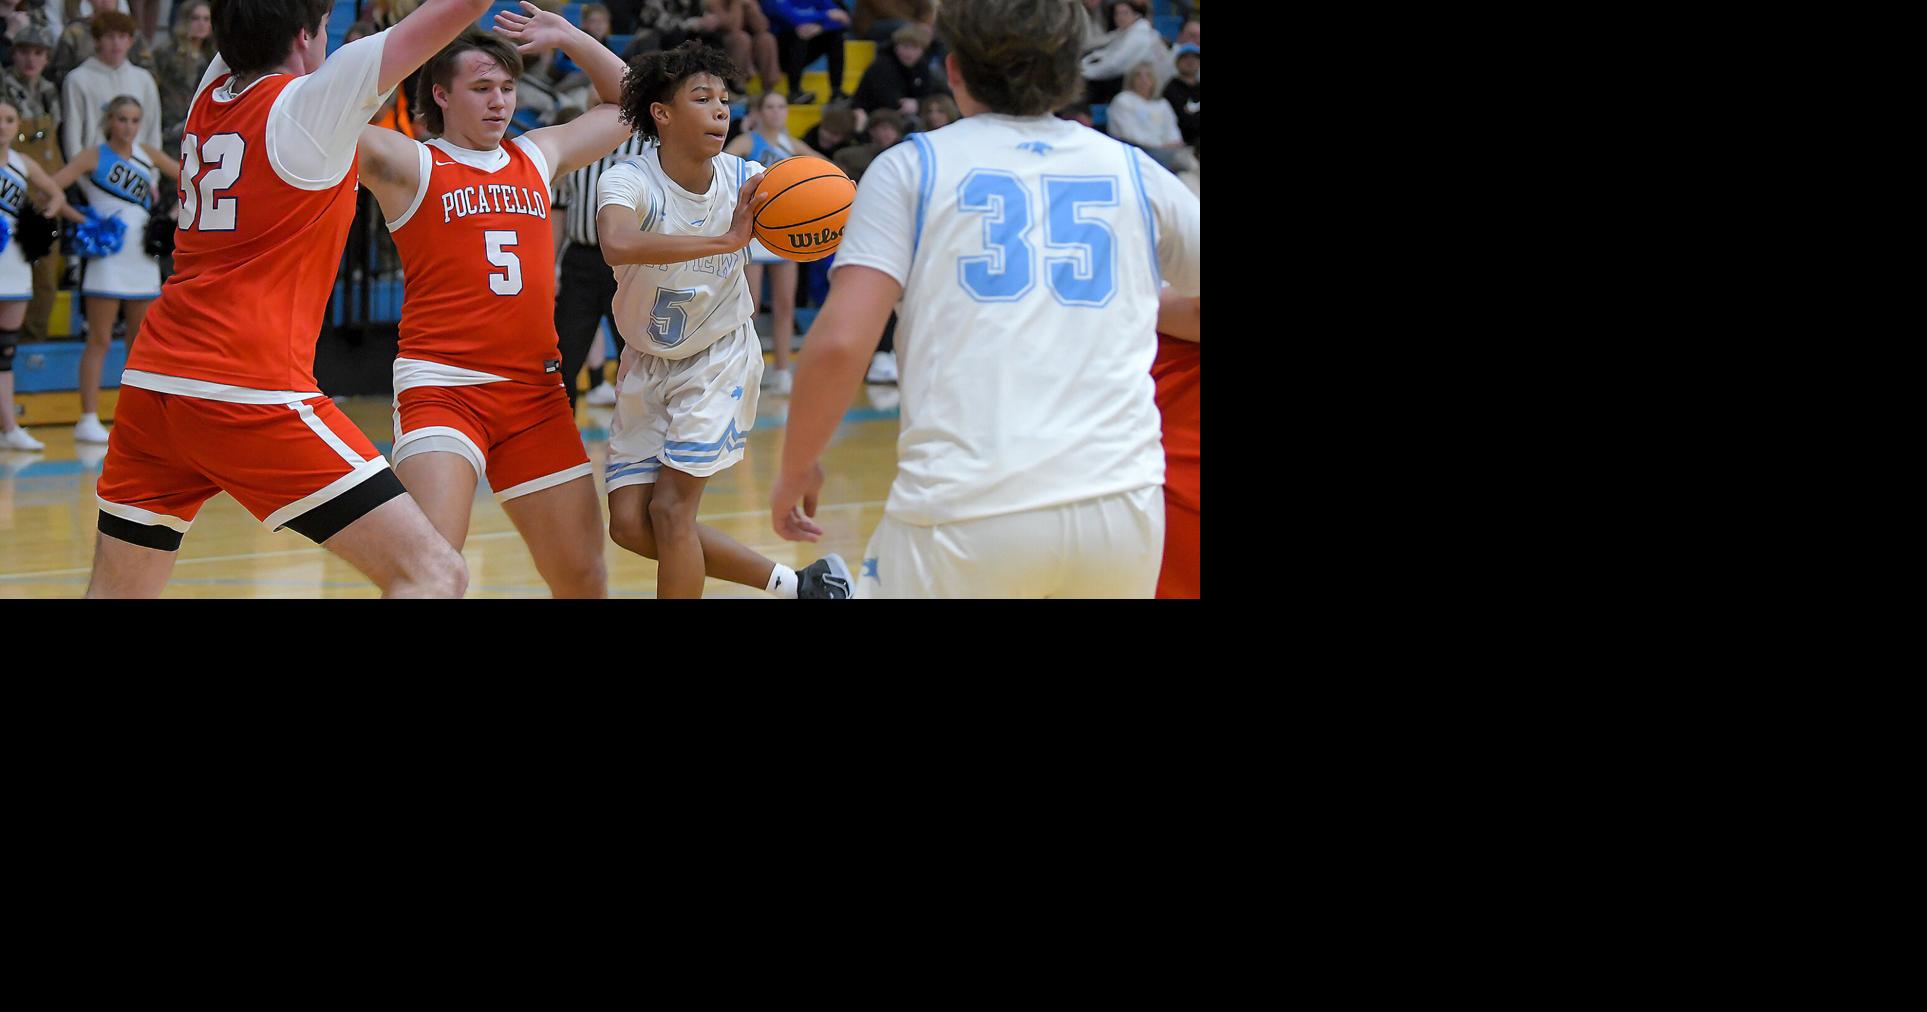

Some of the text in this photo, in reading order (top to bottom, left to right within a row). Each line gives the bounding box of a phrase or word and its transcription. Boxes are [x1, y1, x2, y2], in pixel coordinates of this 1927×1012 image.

[178, 132, 246, 231] 32
[441, 184, 546, 224] POCATELLO
[484, 230, 524, 296] 5
[957, 168, 1120, 308] 35
[647, 286, 696, 347] 5
